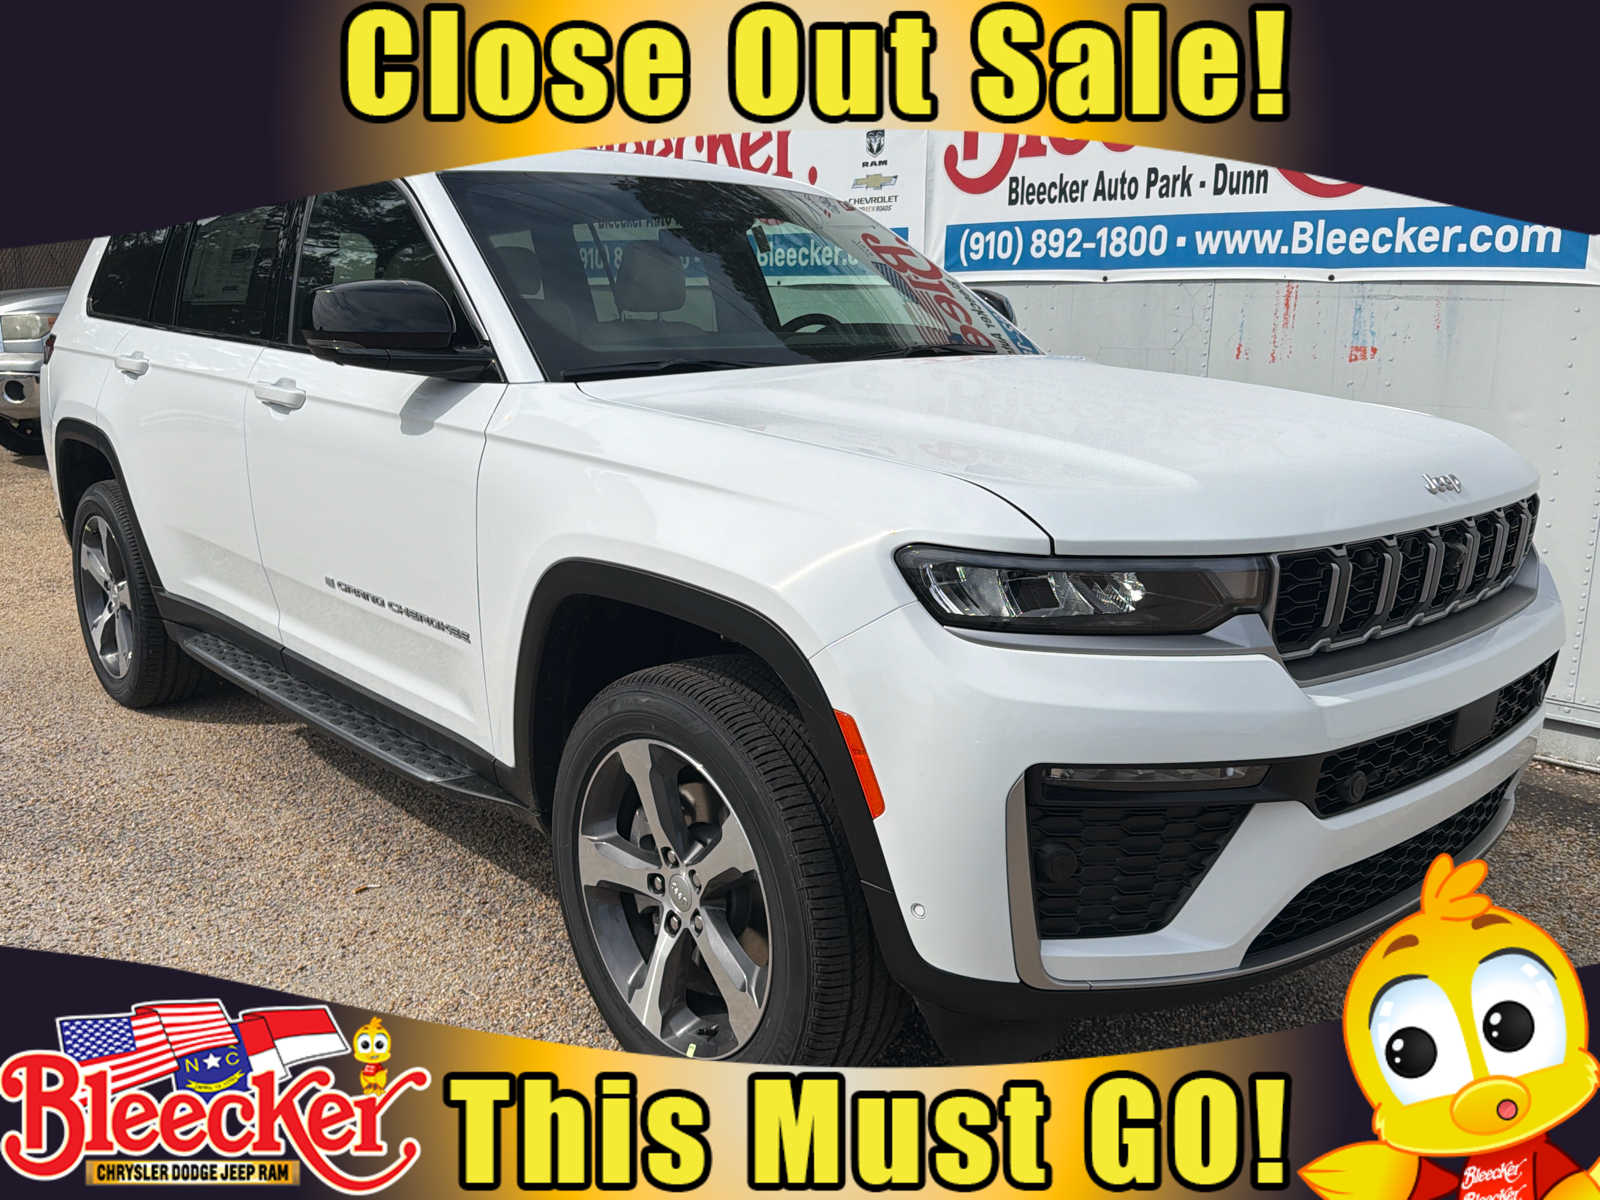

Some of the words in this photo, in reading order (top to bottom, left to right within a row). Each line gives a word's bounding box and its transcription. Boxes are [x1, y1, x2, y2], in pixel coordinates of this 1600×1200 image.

[862, 159, 888, 168] RAM
[1008, 173, 1088, 206] Bleecker
[1093, 170, 1139, 202] Auto
[1145, 164, 1193, 199] Park
[1213, 163, 1269, 196] Dunn
[959, 224, 1024, 267] (910)
[1030, 223, 1168, 258] 892-1800
[1194, 216, 1562, 255] www.Bleecker.com
[1422, 473, 1462, 495] Jeep
